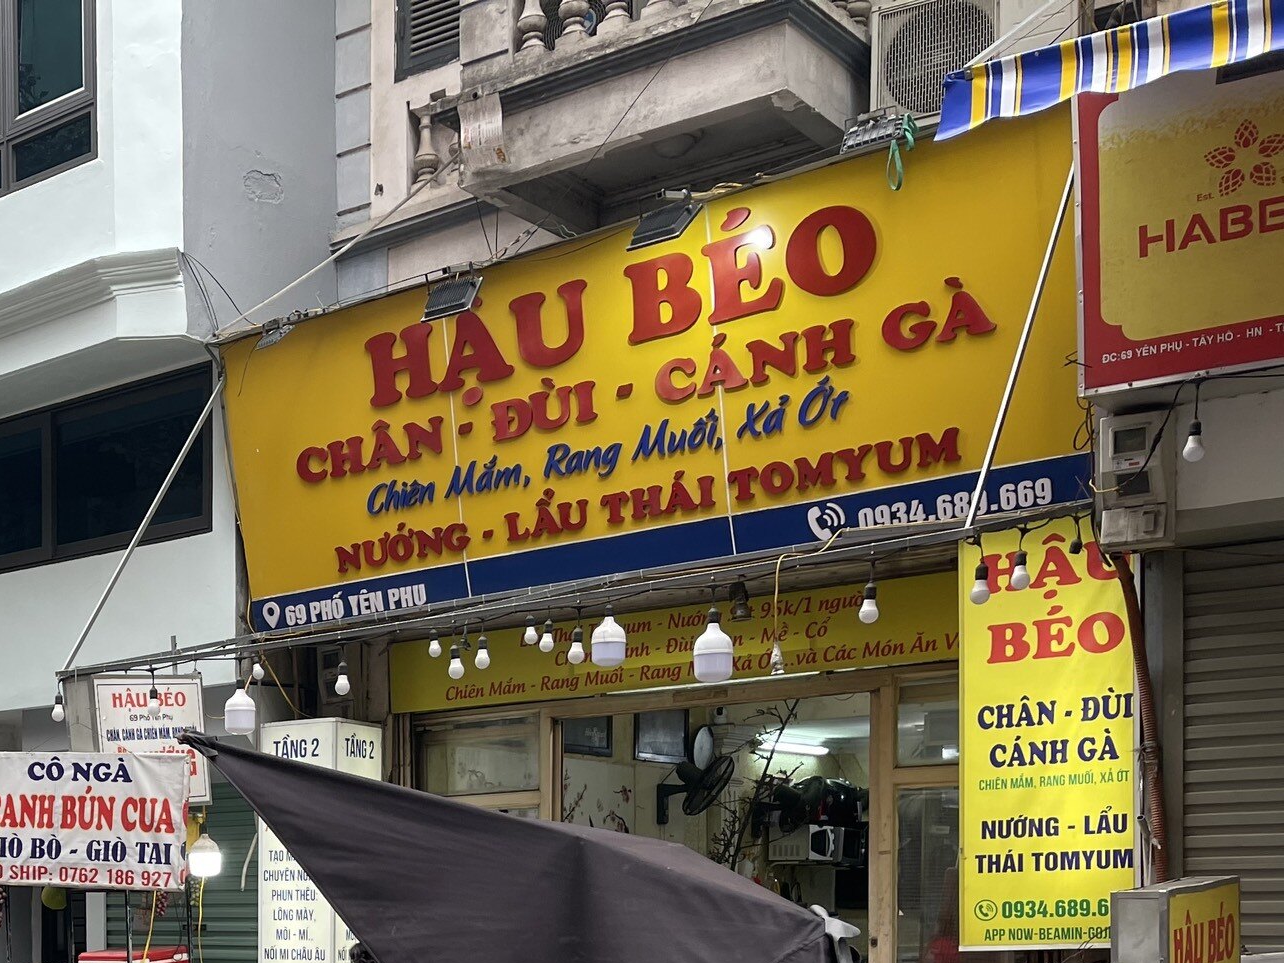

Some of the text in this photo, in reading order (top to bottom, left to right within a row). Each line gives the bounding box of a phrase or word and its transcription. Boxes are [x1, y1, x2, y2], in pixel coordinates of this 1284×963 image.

[365, 205, 877, 408] HẬU BÉO
[1136, 344, 1158, 357] YÊN
[1192, 334, 1214, 347] TÂY
[1246, 326, 1262, 338] HN
[296, 277, 998, 484] CHÂN ĐÙI CÁNH GÀ
[366, 375, 850, 516] Chiên Mắm, Rang Muối, Xả Ớt
[335, 427, 962, 573] NƯỚNG LẨU THÁI TOMYUM
[285, 590, 384, 626] 69 YÊN
[987, 605, 1125, 664] BÉO
[446, 684, 484, 701] Chiên
[489, 677, 526, 695] Mắm
[540, 673, 580, 693] Rang
[584, 665, 624, 687] Muối
[640, 664, 682, 683] Rang
[822, 643, 856, 662] Các
[862, 636, 907, 660] Món
[911, 631, 939, 654] Ăn
[112, 688, 147, 712] HẬU
[977, 687, 1134, 730] CHÂN ĐÙI
[311, 738, 319, 757] 2
[369, 741, 375, 759] 2
[989, 728, 1119, 768] CÁNH GÀ
[28, 756, 64, 781] CÔ
[72, 757, 133, 783] NGÀ
[979, 776, 1007, 791] CHIÊN
[1039, 774, 1066, 787] RANG
[1100, 767, 1114, 783] XẢ
[60, 786, 116, 831] BÚN
[121, 796, 175, 833] CUA
[982, 806, 1128, 840] NƯỚNG LẨU
[31, 834, 62, 860] BÒ
[86, 837, 126, 862] GIÒ
[136, 842, 172, 865] TAI
[975, 848, 1133, 874] THÁI TOMYUM
[10, 865, 171, 888] SHIP: 0762 186 927
[263, 869, 295, 882] CHUYÊN
[271, 890, 293, 901] PHUN
[273, 907, 293, 921] LÔNG
[984, 928, 1006, 941] APP
[279, 948, 289, 960] MI
[291, 947, 313, 961] CHÂU
